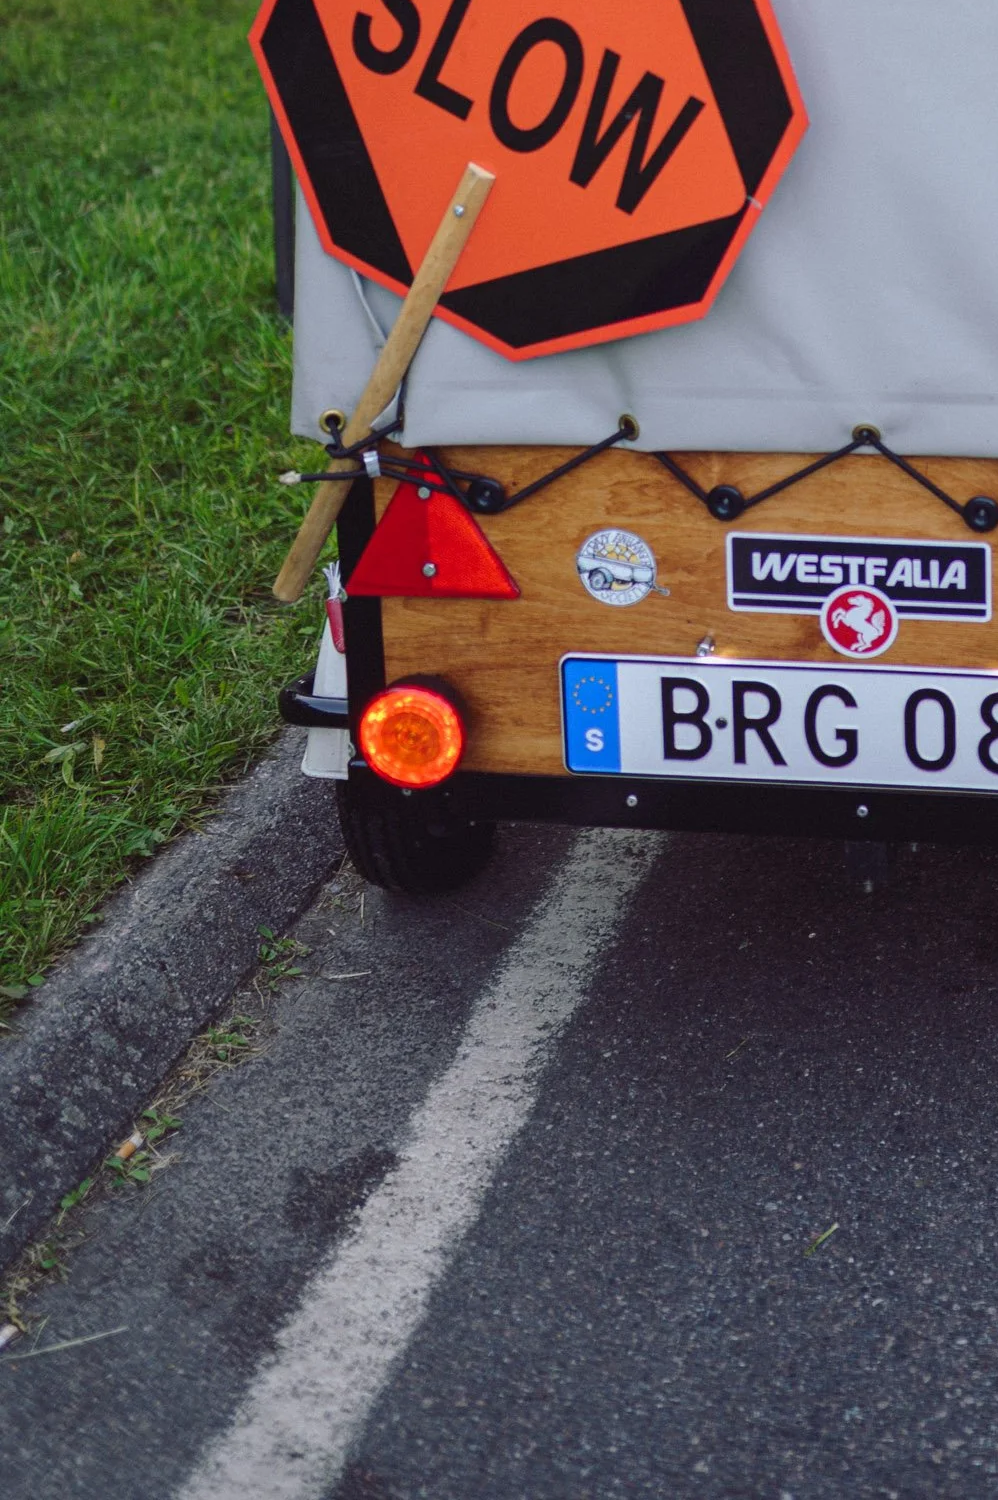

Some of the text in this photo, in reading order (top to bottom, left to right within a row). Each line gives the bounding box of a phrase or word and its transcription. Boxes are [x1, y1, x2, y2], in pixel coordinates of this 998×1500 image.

[752, 552, 966, 589] WESTFALIA
[585, 728, 604, 752] S
[660, 676, 858, 768] BRG
